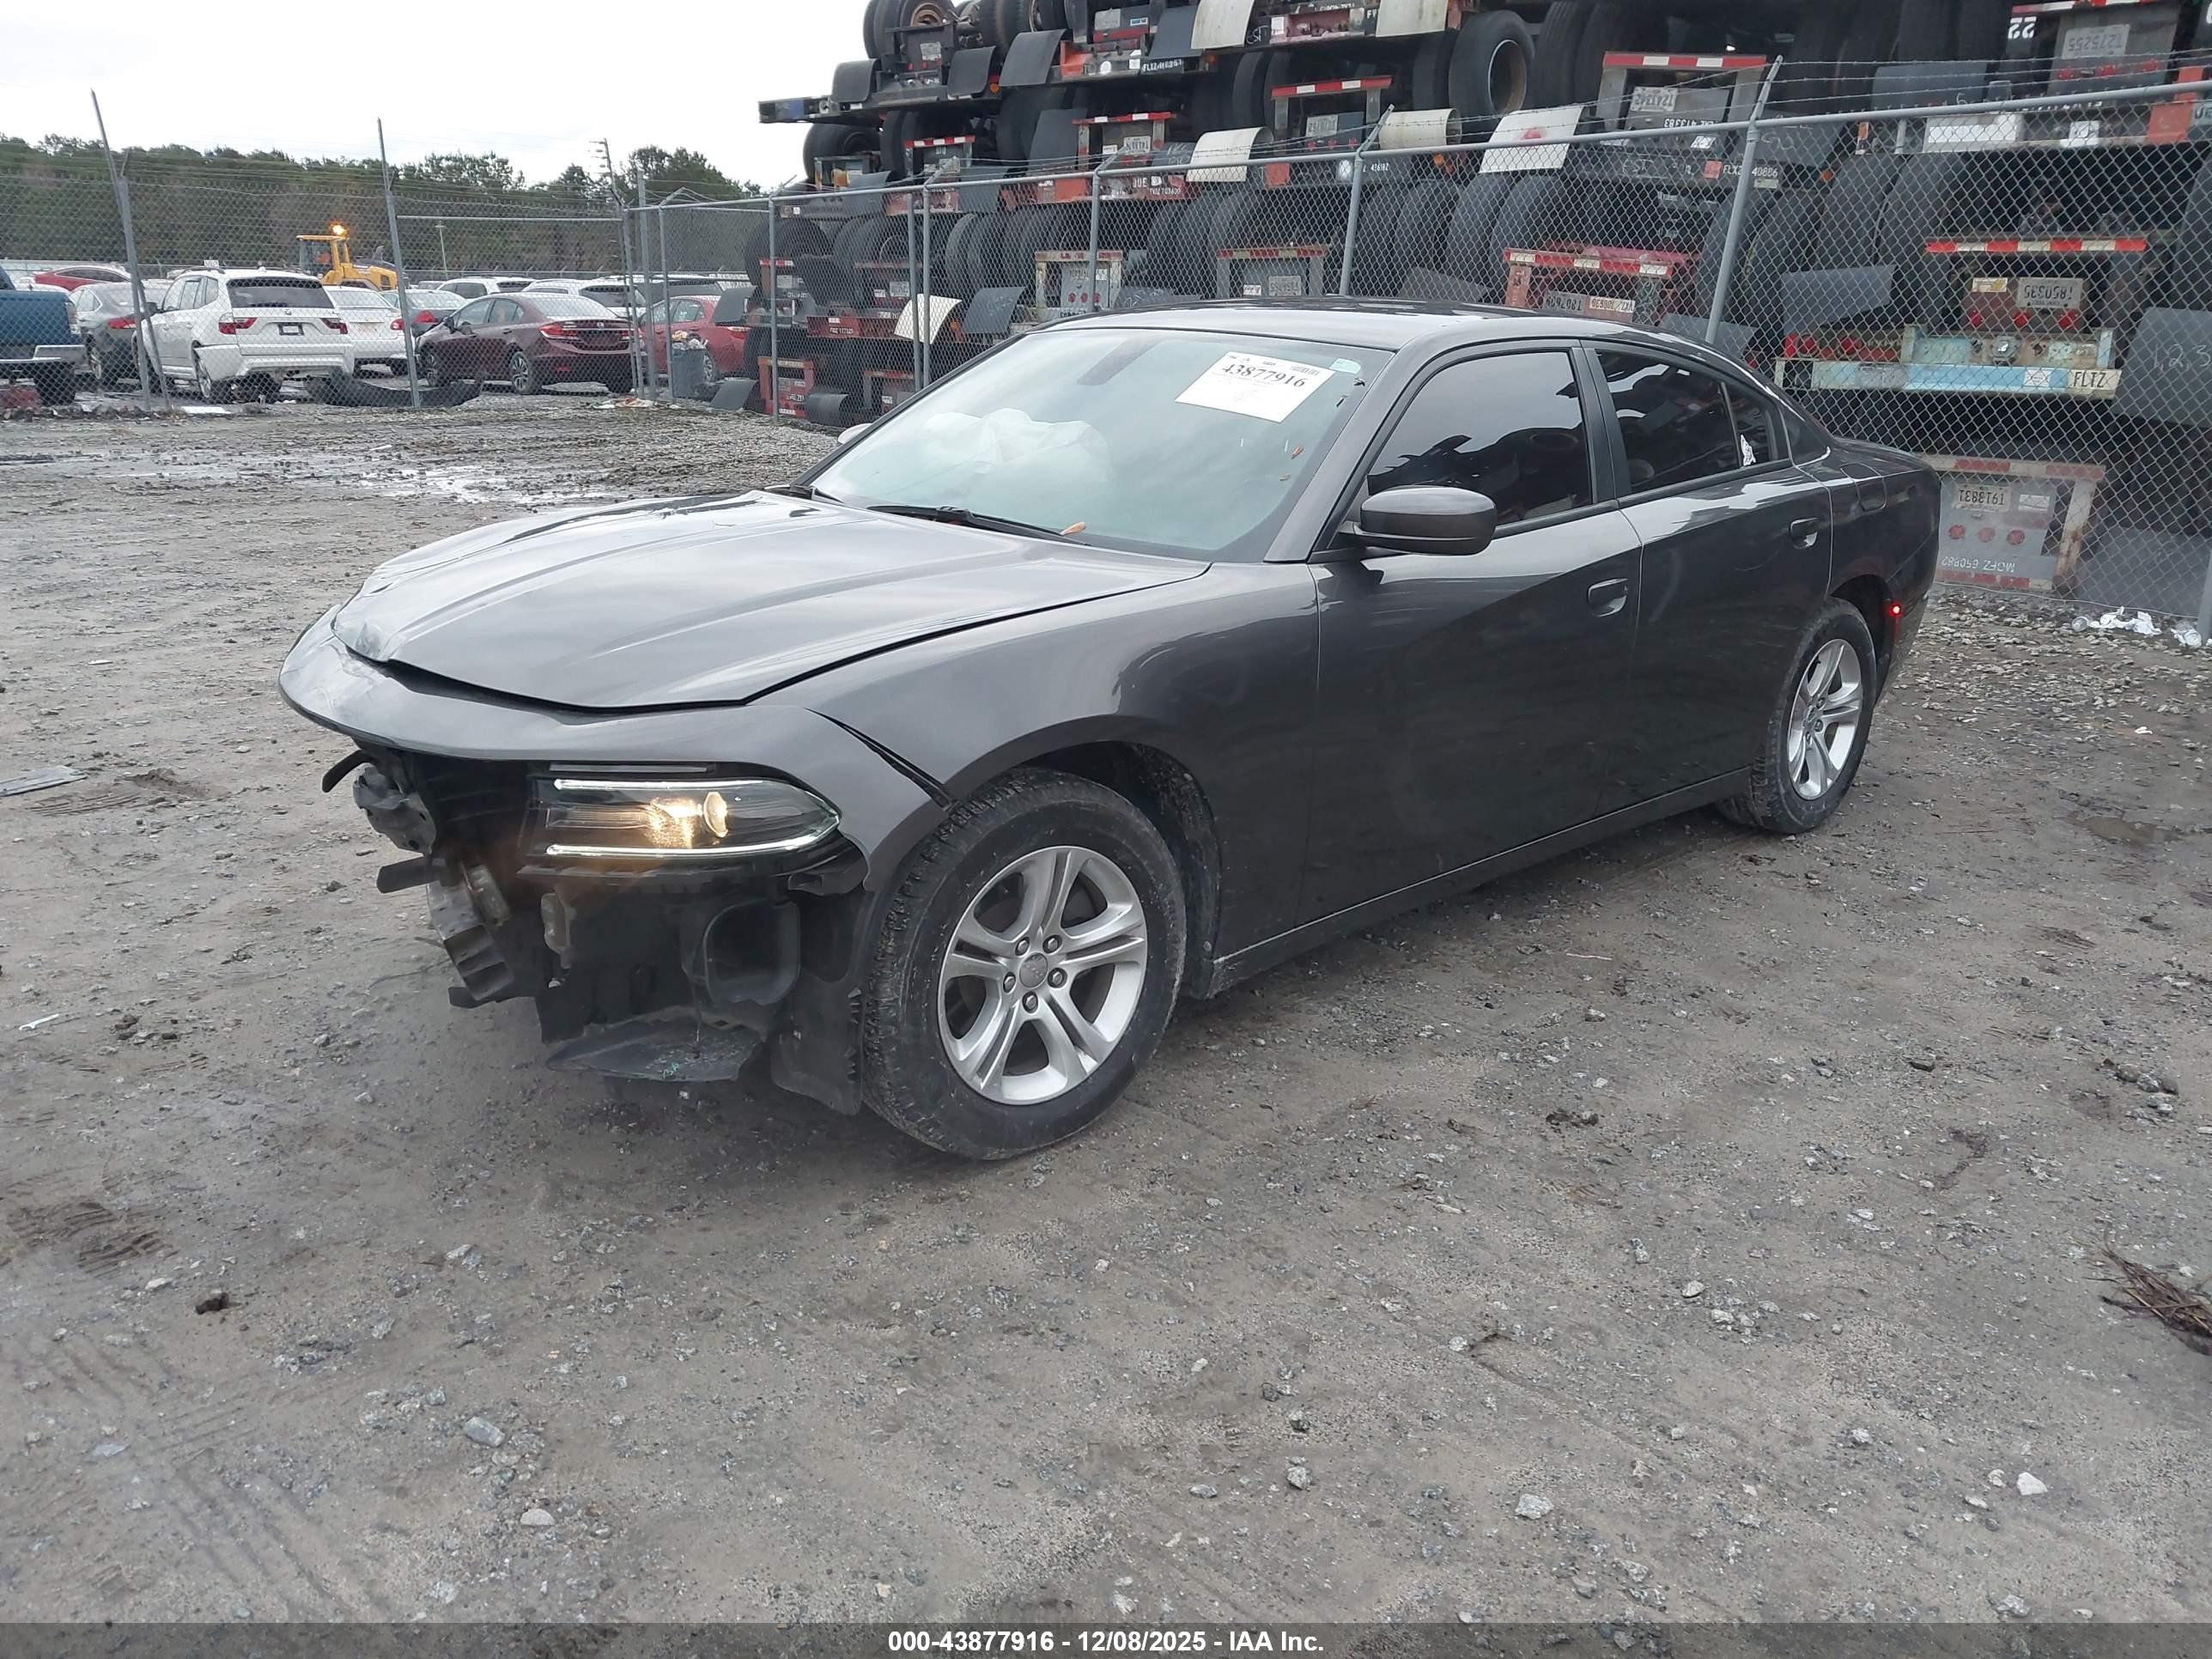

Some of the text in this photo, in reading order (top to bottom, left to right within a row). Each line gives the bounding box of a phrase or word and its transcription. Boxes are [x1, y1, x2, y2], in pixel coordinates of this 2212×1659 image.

[2008, 16, 2037, 39] 22
[1222, 363, 1306, 387] 43877916
[2073, 370, 2107, 389] FLTZ
